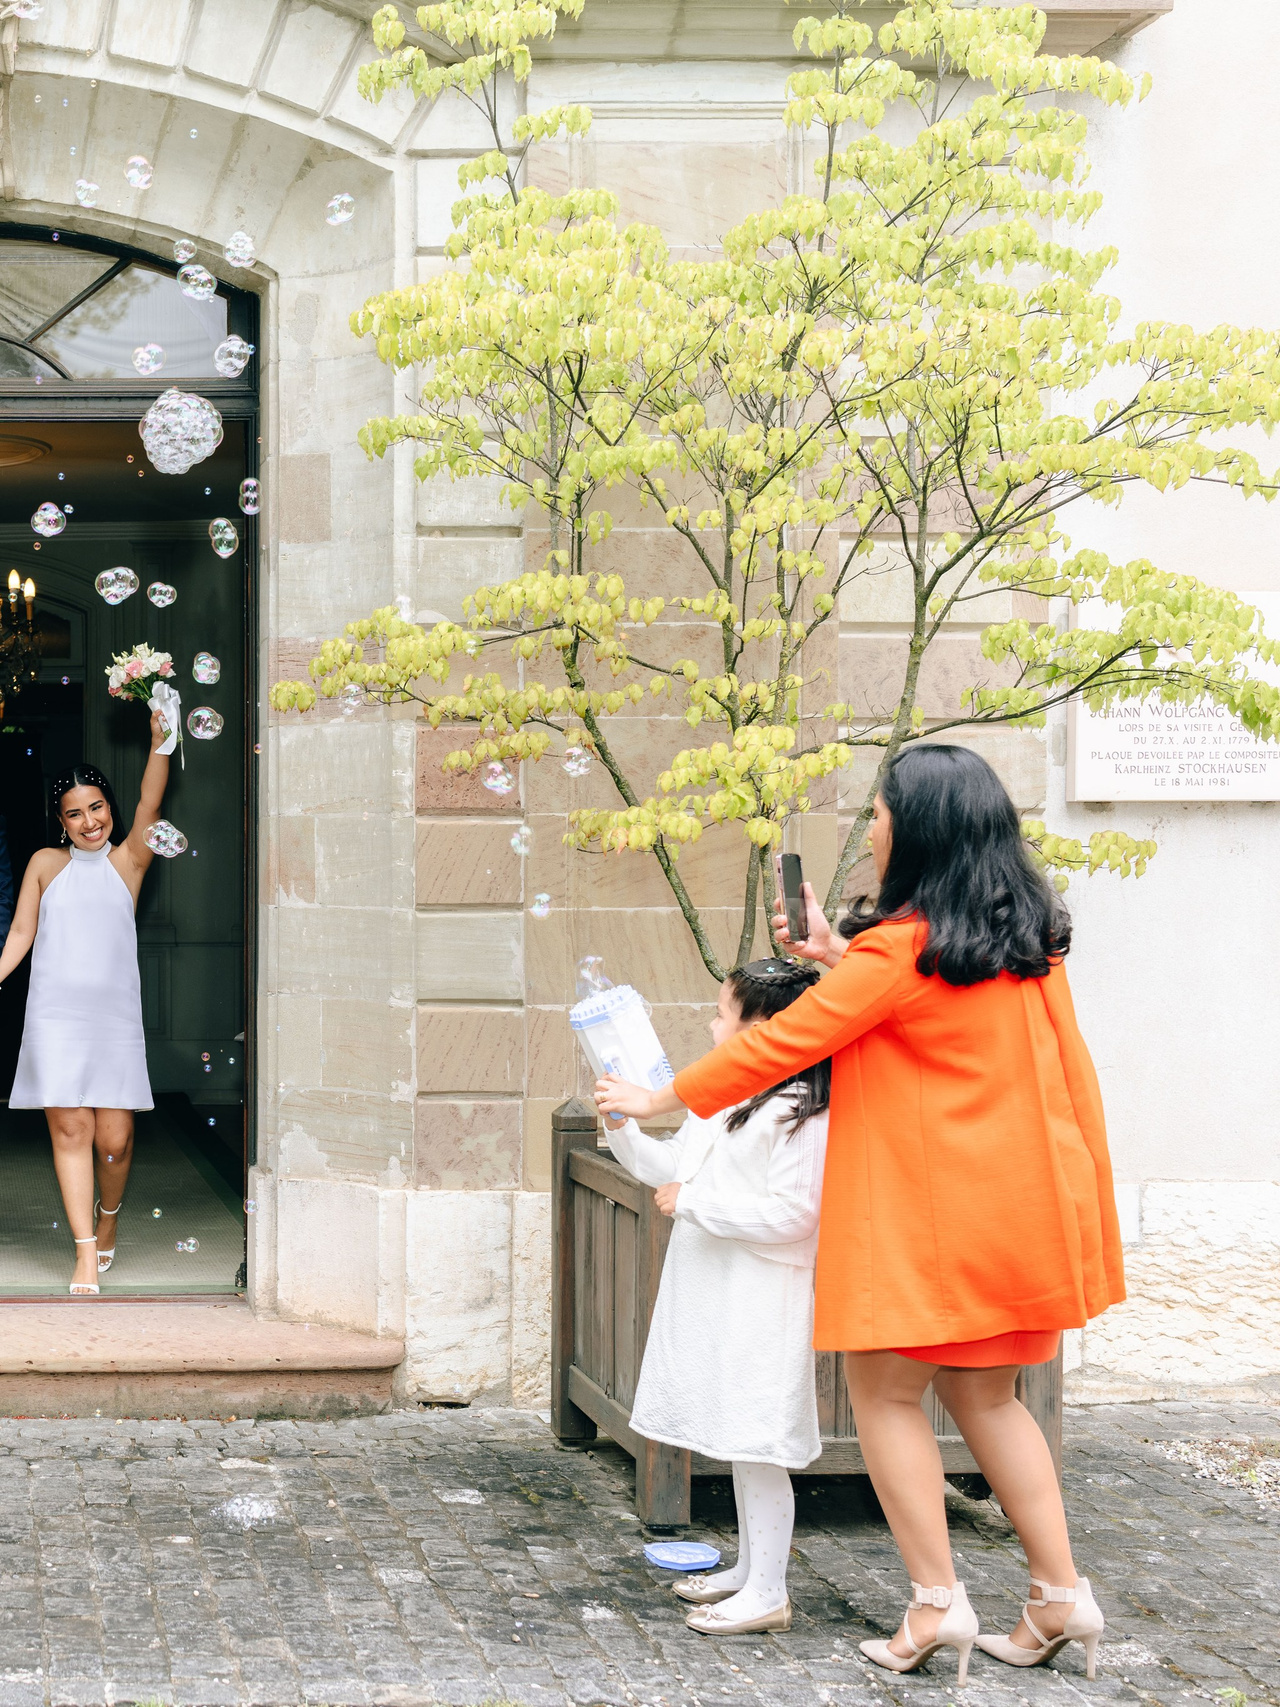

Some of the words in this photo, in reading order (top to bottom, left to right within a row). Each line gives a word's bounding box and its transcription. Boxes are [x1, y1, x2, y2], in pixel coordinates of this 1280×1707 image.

[1118, 723, 1144, 732] LORS
[1148, 723, 1161, 732] DE
[1166, 723, 1180, 732] SA
[1183, 723, 1213, 732] VISITE
[1133, 736, 1147, 745] DU
[1182, 736, 1196, 745] AU
[1091, 751, 1132, 760] PLAQUE
[1209, 751, 1220, 760] LE
[1224, 750, 1280, 760] COMPOSITE
[1114, 763, 1171, 774] KARLHEINZ
[1177, 762, 1267, 774] STOCKHAUSEN
[1154, 777, 1166, 787] LE
[1171, 777, 1181, 787] 18
[1185, 777, 1204, 786] MAI
[1208, 777, 1230, 787] 1981
